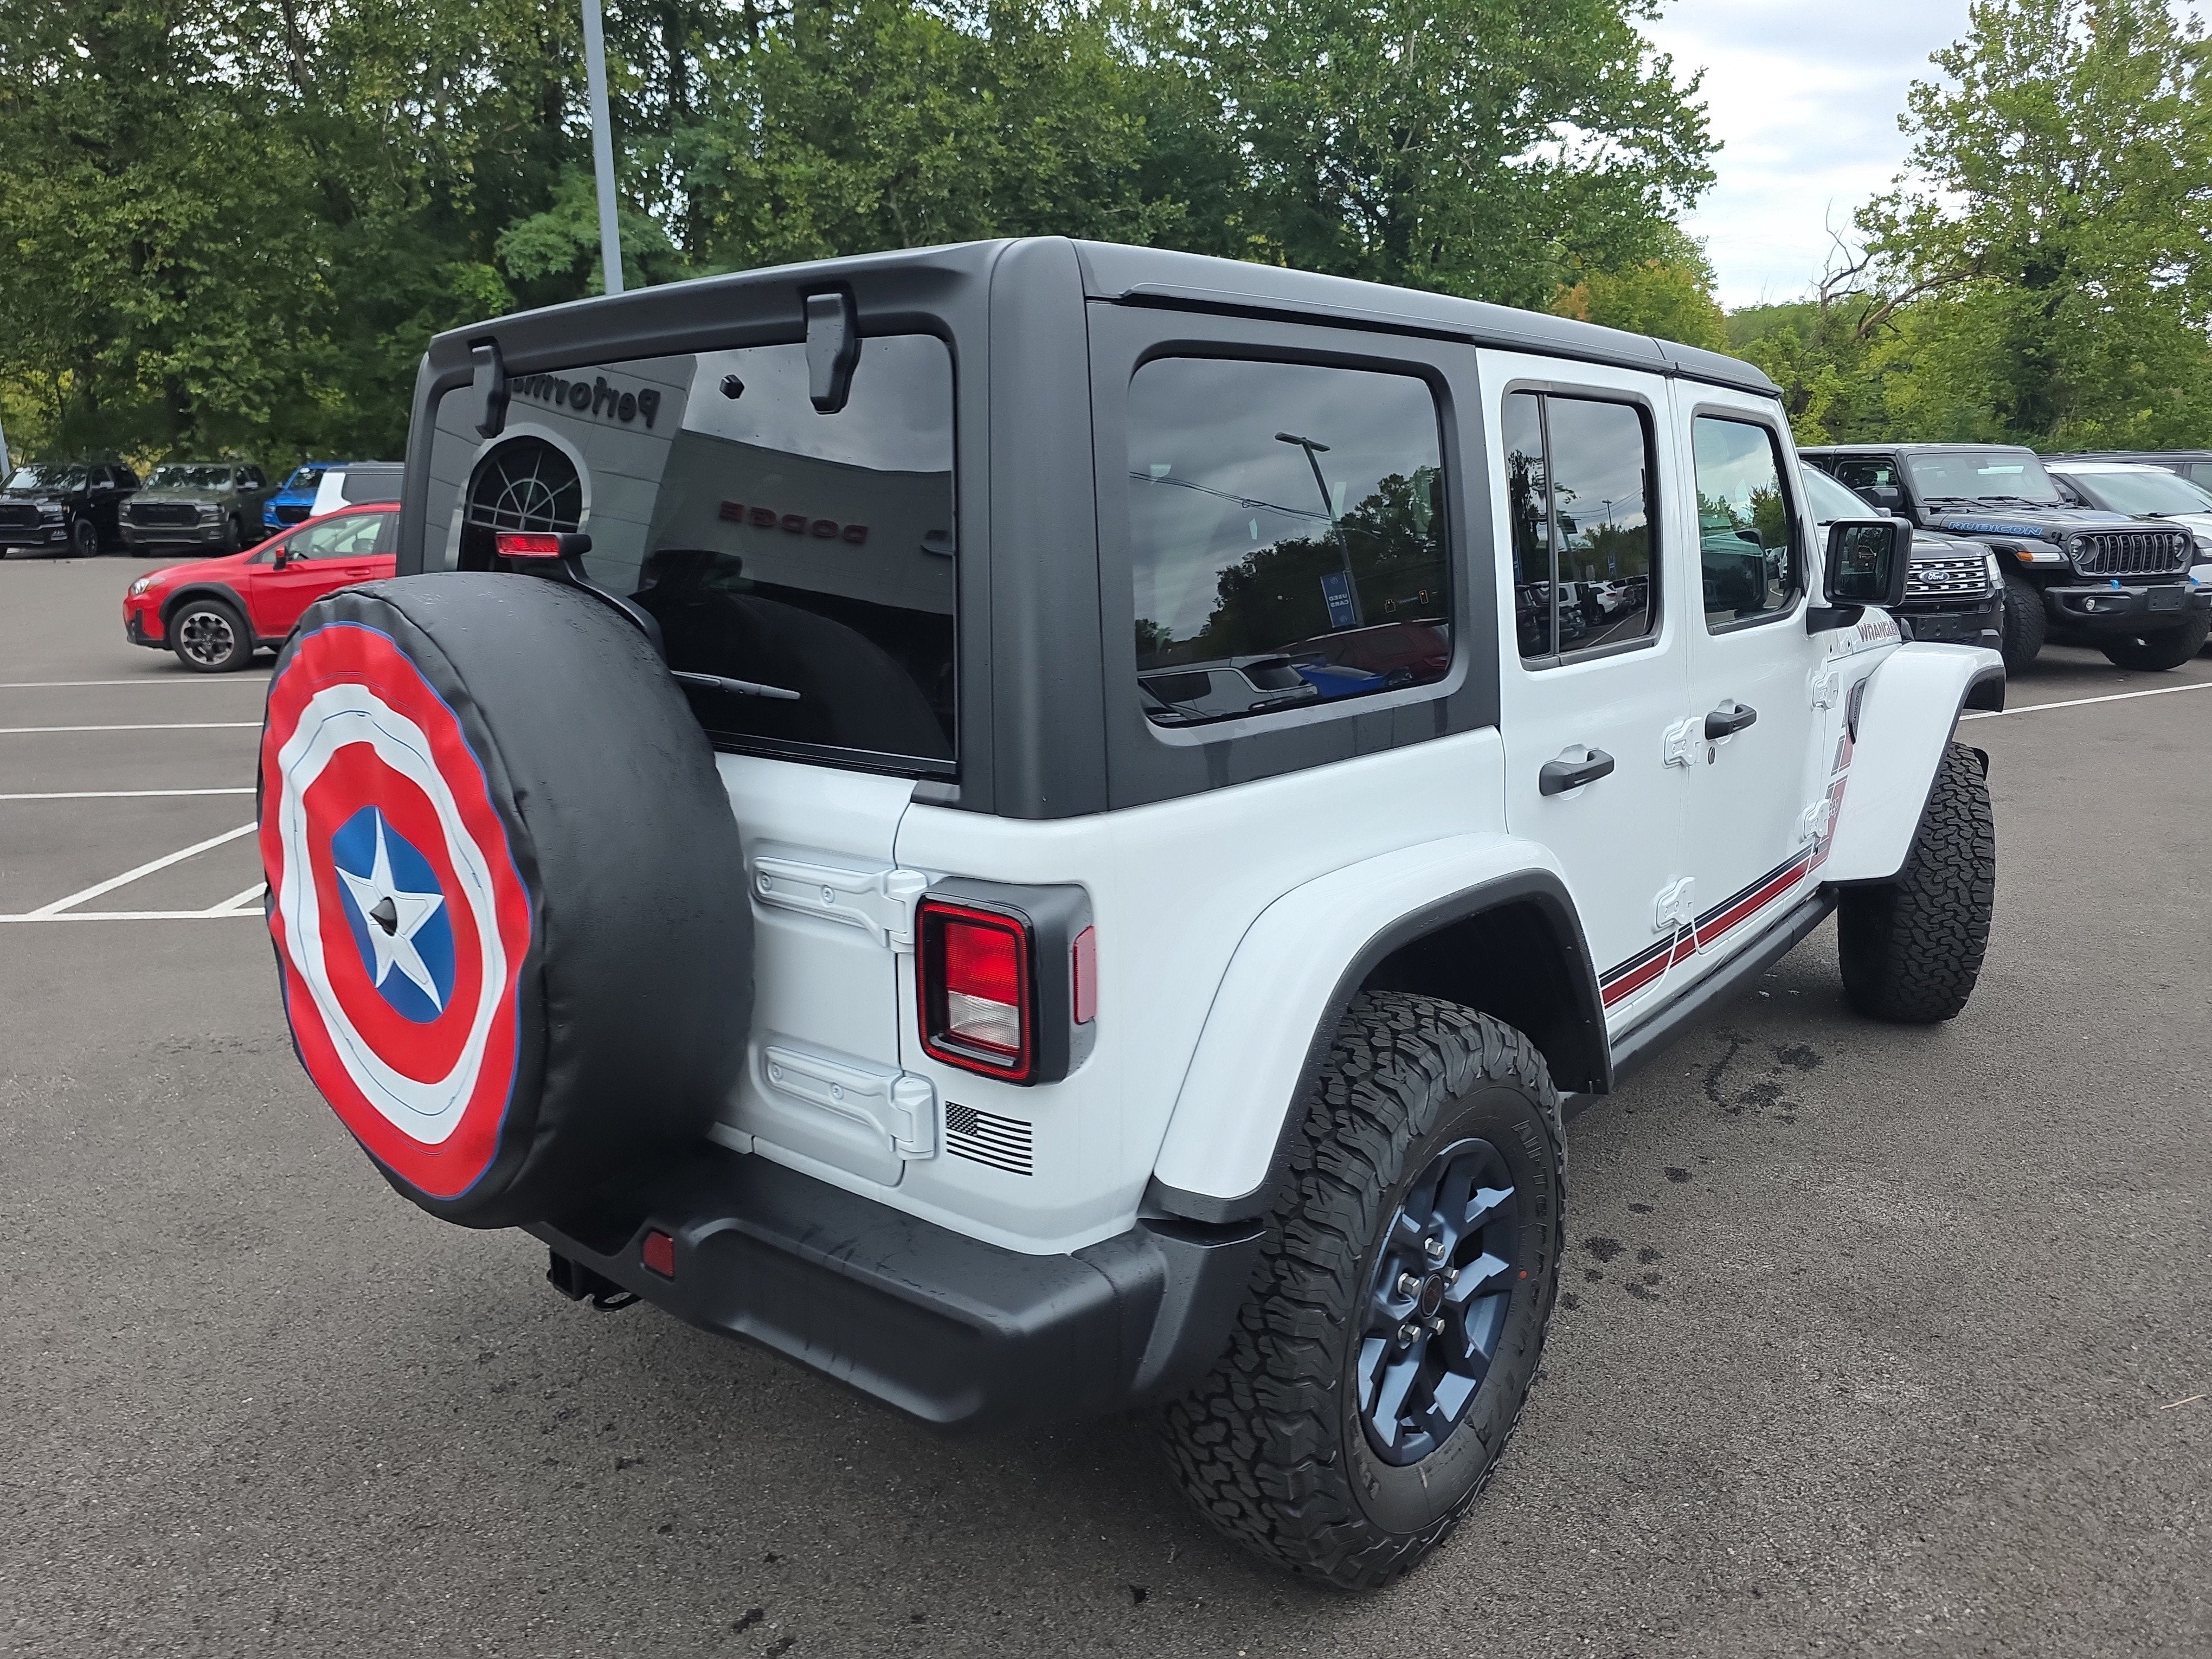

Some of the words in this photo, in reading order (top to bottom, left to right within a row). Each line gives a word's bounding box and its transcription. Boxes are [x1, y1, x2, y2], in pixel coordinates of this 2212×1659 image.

[1948, 522, 2043, 536] RUBICON
[1928, 572, 1944, 580] Ford
[1856, 620, 1899, 642] WRANGLER
[1829, 796, 1840, 819] eep
